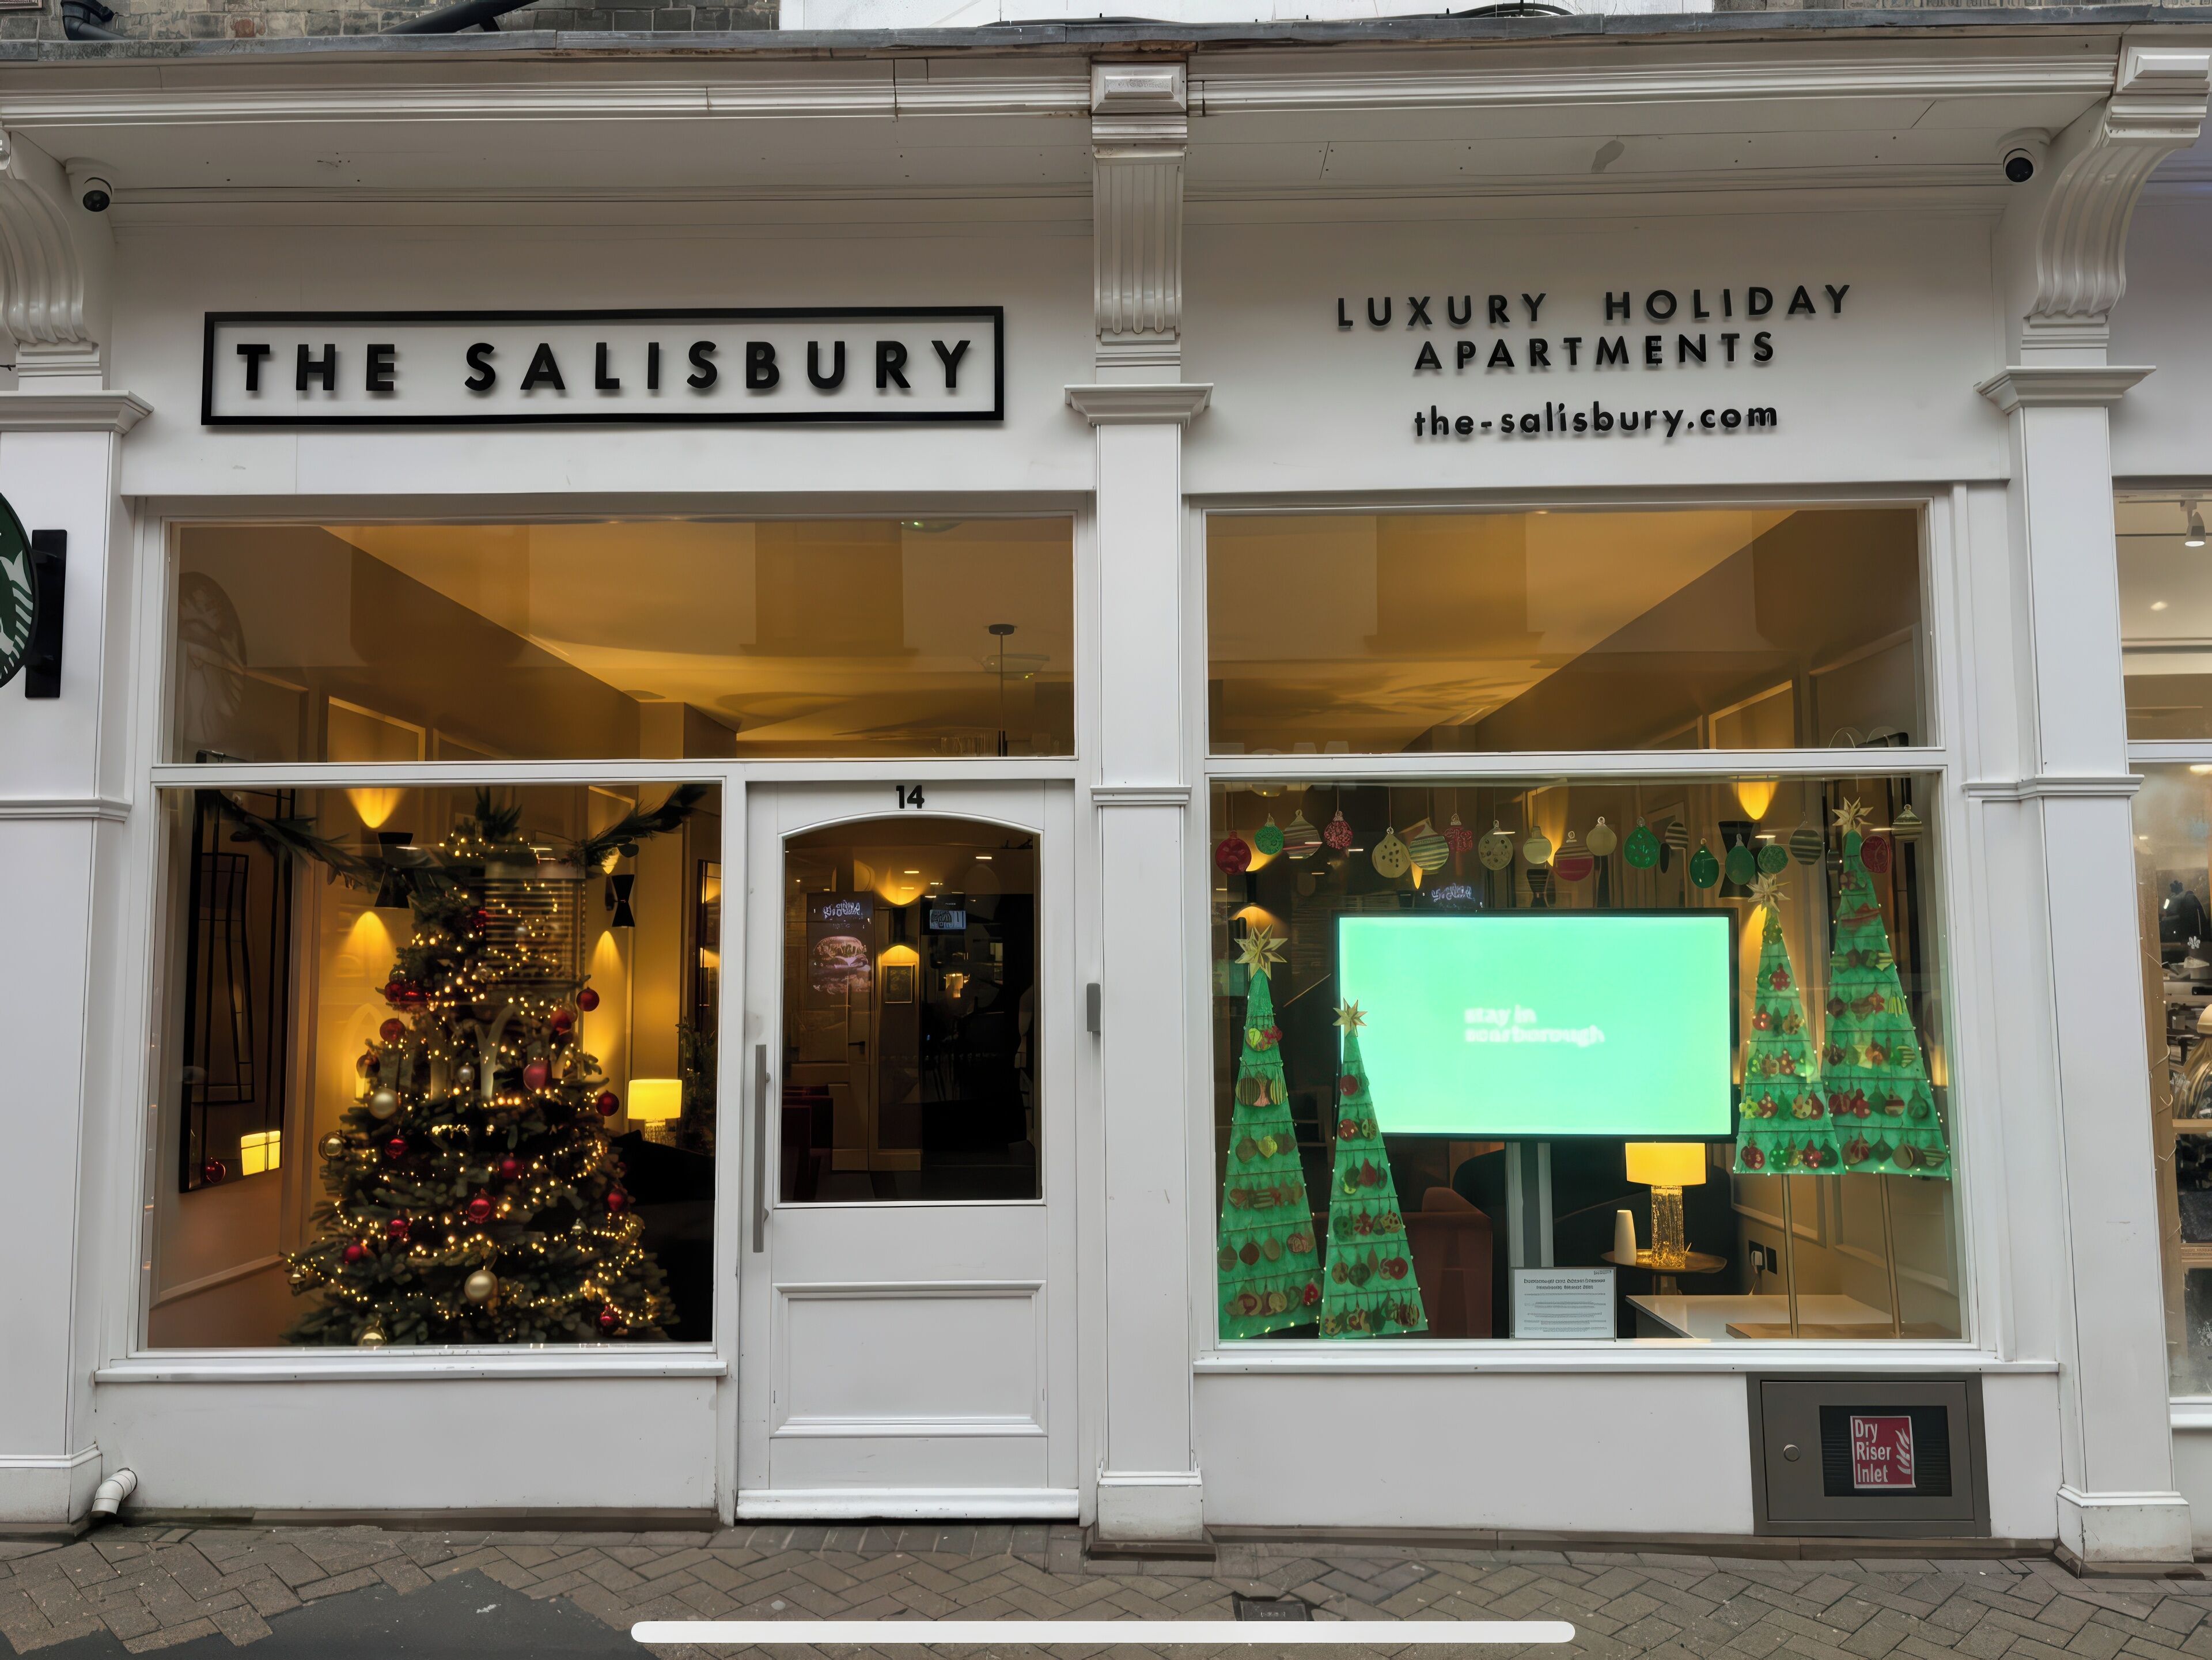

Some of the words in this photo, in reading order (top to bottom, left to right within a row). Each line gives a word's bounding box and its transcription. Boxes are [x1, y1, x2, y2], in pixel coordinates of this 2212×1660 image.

[1337, 293, 1547, 330] LUXURY
[1605, 283, 1851, 322] HOLIDAY
[236, 343, 396, 392] THE
[464, 339, 971, 391] SALISBURY
[1414, 331, 1775, 370] APARTMENTS
[1413, 400, 1778, 438] the-salisbury.com
[896, 785, 925, 810] 14
[1854, 1419, 1878, 1443] Dry
[1856, 1441, 1892, 1461] Riser
[1857, 1463, 1889, 1483] Inlet
